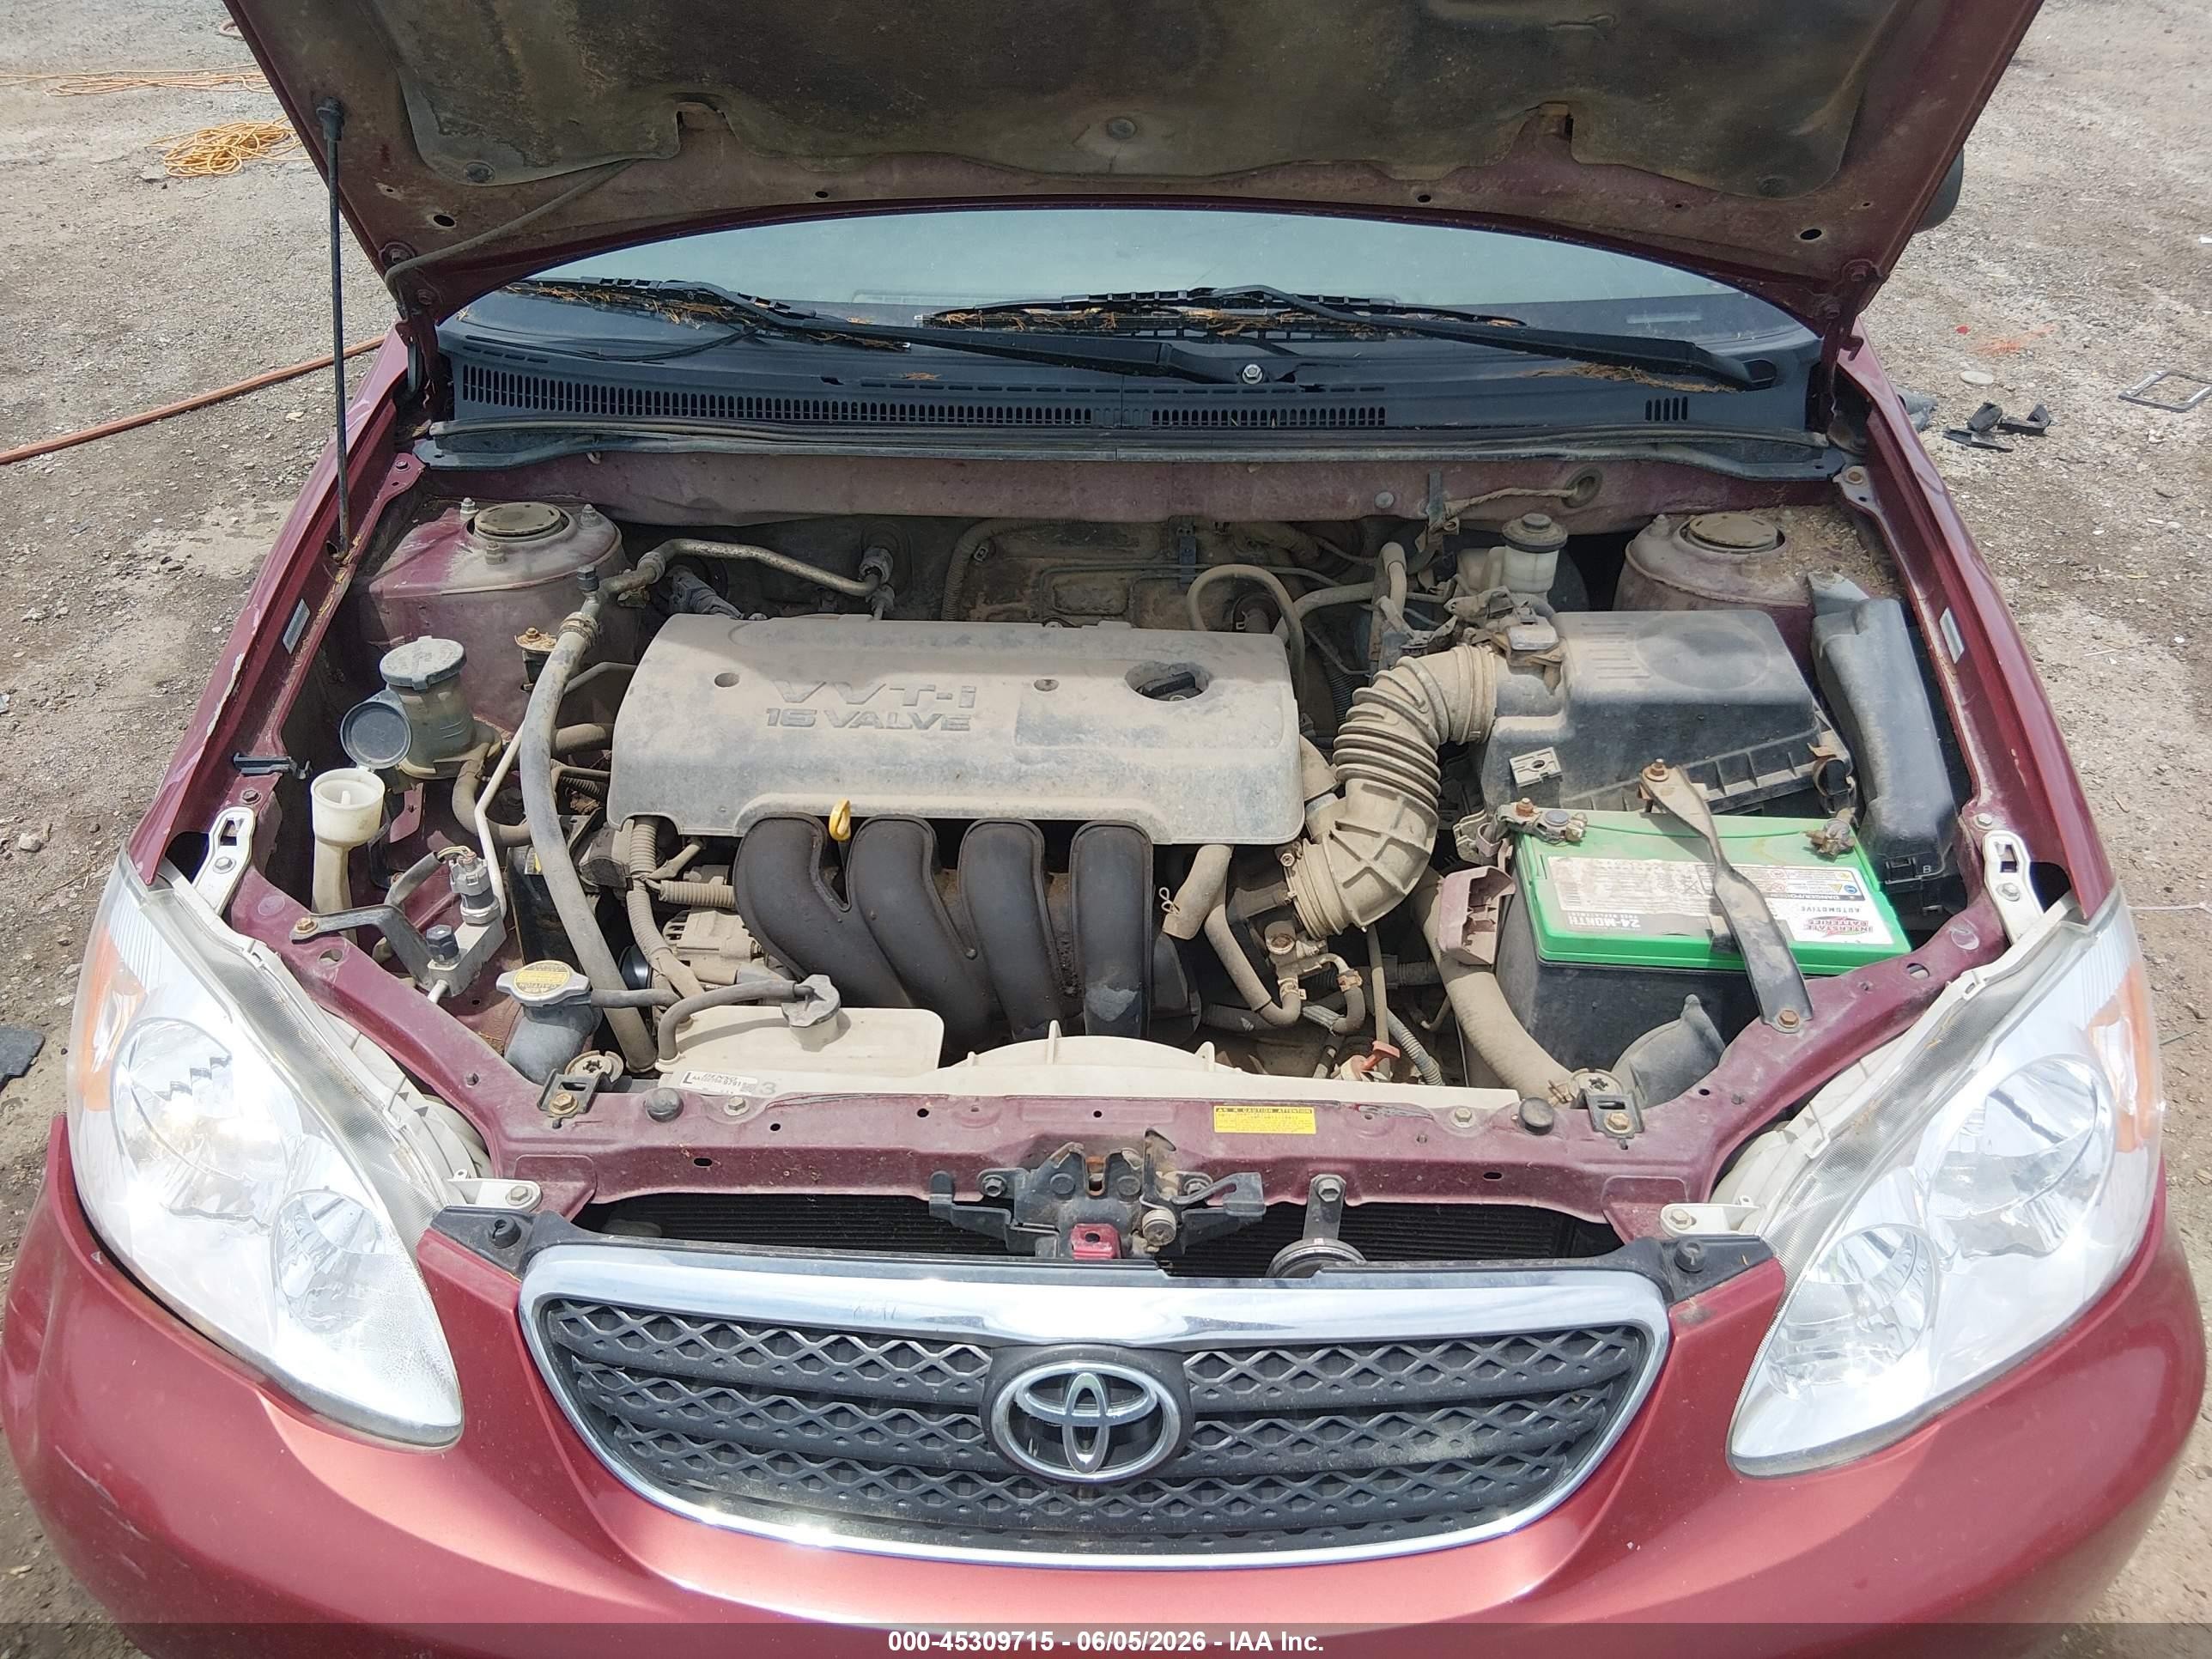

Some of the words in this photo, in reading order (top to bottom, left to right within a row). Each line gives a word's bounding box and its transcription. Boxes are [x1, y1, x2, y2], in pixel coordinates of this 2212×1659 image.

[766, 708, 817, 728] 16
[823, 709, 973, 732] VALVE
[1568, 916, 1641, 928] 24-MONTH
[1805, 925, 1874, 933] INTERSTATE
